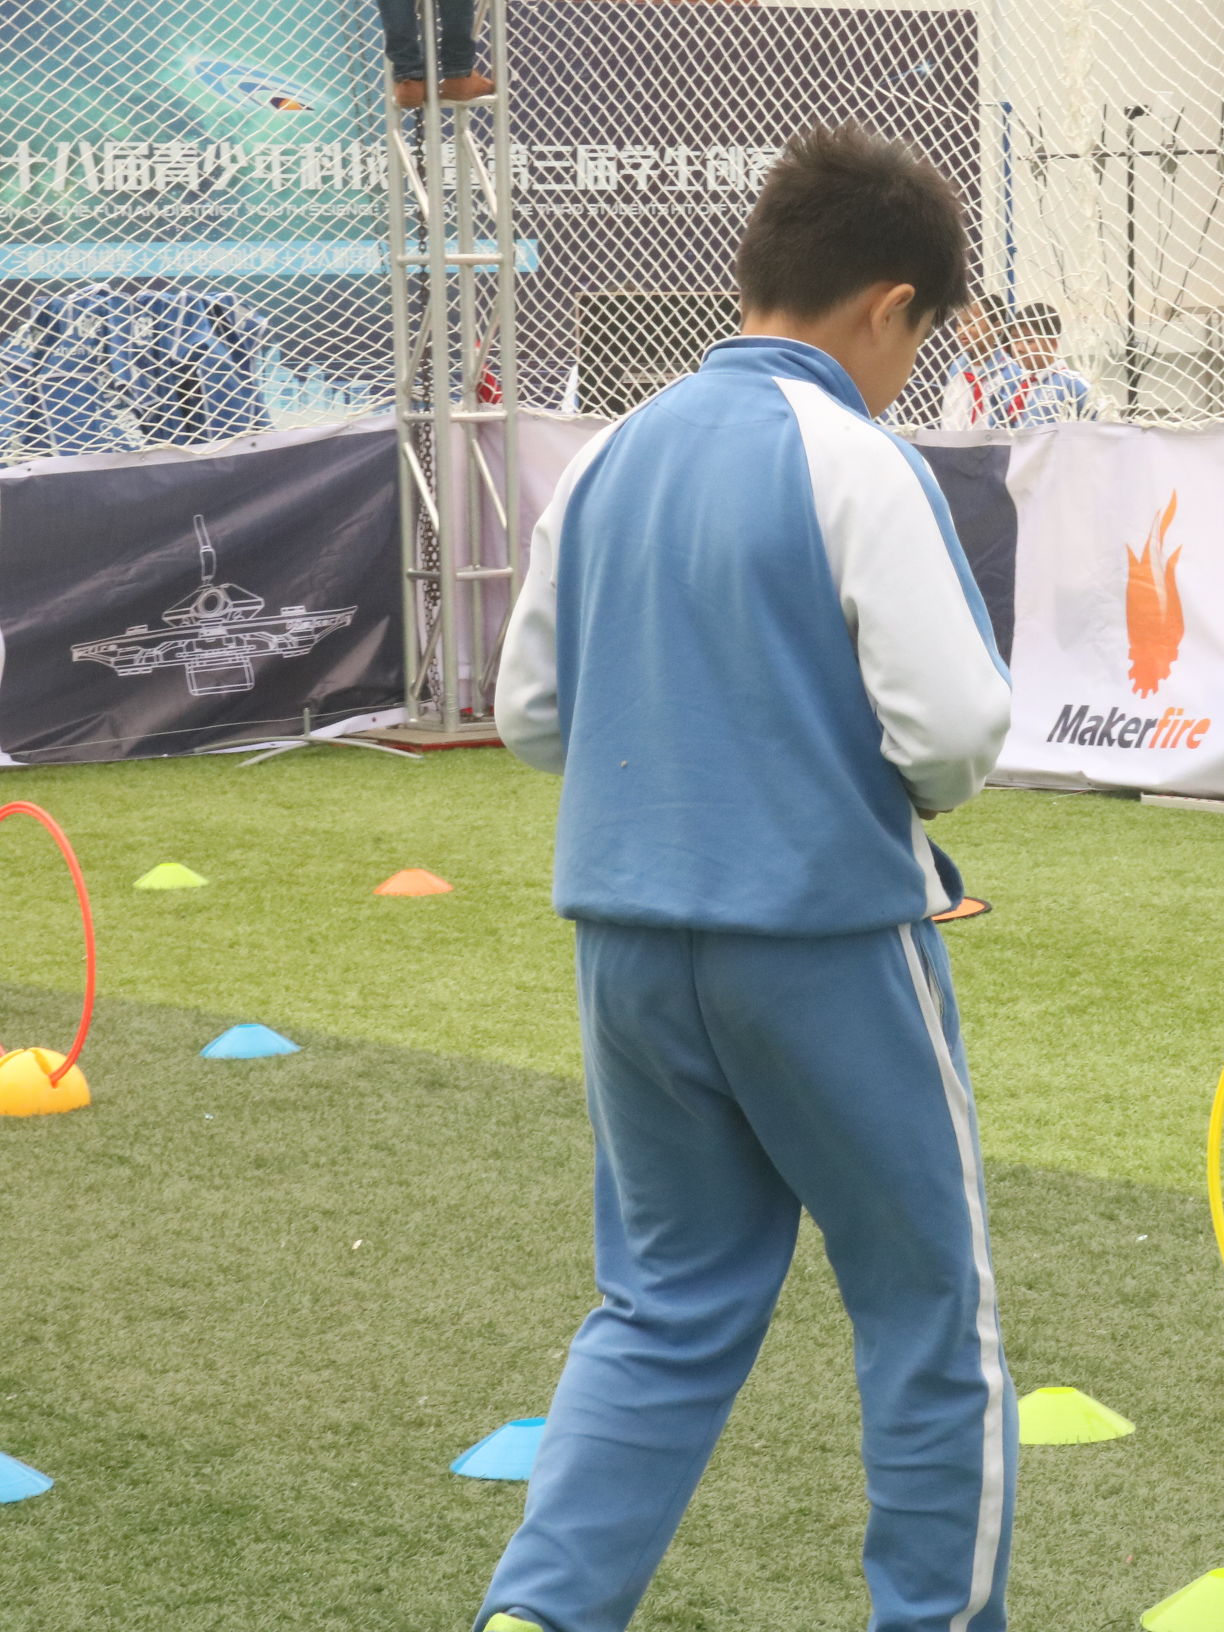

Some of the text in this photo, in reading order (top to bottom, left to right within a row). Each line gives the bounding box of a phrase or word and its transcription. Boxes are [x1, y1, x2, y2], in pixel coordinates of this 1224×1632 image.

[162, 205, 240, 216] DISTRICT
[308, 204, 380, 216] SCIENCE
[1046, 704, 1211, 749] Makerfire
